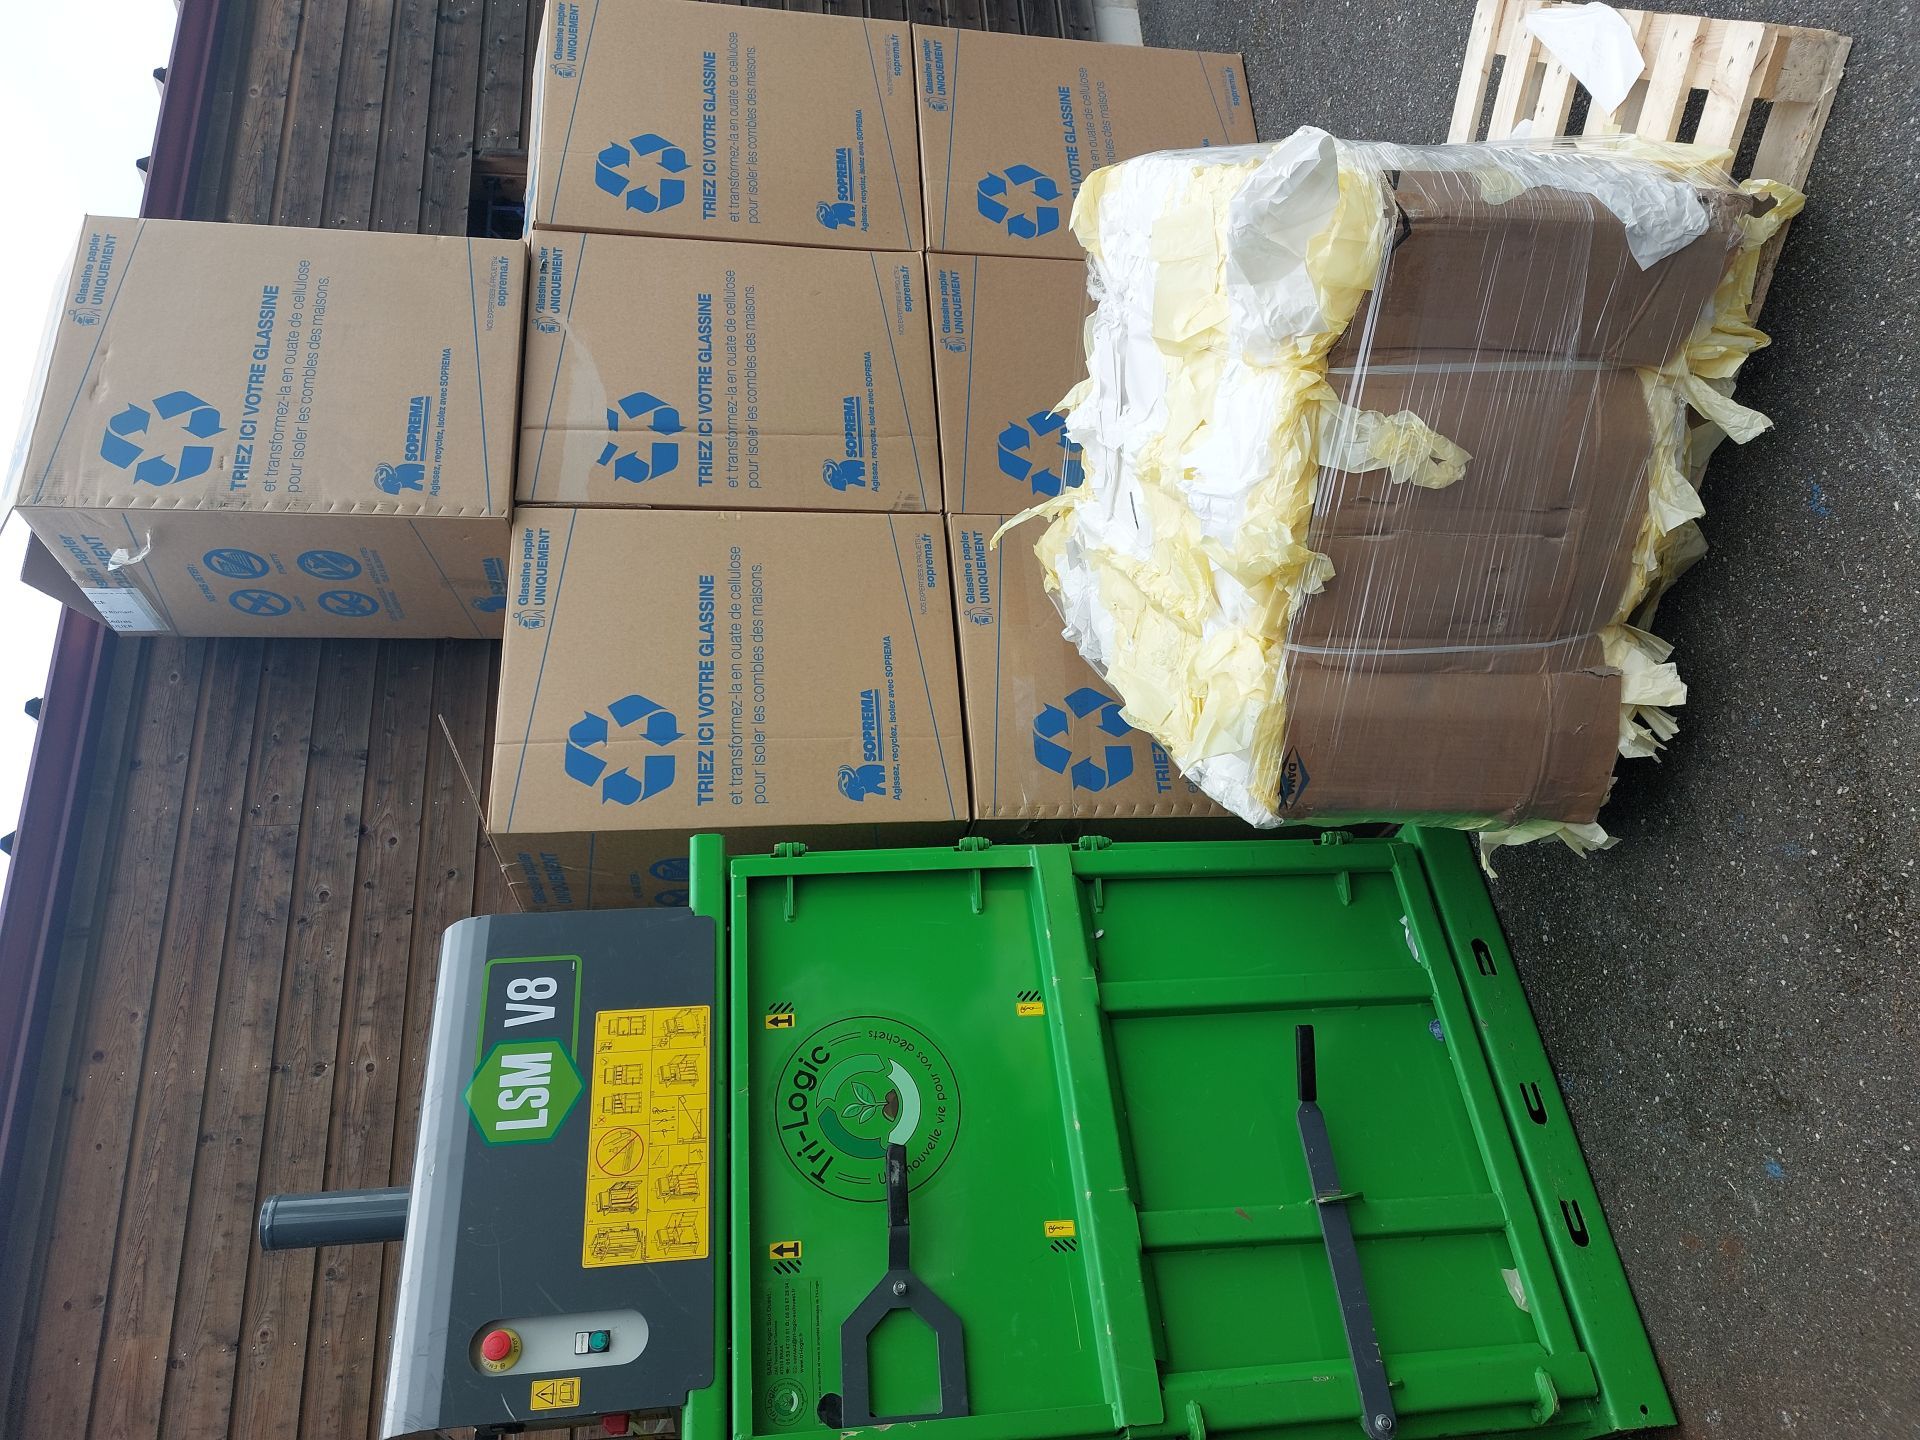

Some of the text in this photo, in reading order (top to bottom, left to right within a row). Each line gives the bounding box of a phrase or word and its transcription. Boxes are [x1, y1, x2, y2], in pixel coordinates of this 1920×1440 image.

[554, 2, 566, 60] Glassine papier
[567, 4, 578, 61] UNIQUEMENT
[890, 34, 902, 76] soprema.fr
[923, 39, 934, 94] Glassine papier
[934, 40, 946, 96] UNIQUEMENT
[1079, 67, 1092, 106] cellulose
[1225, 67, 1240, 106] soprema.fr
[745, 88, 757, 106] des
[1083, 107, 1094, 120] de
[703, 51, 716, 220] TRIEZ ICI VOTRE GLASSINE
[727, 32, 740, 222] et transformez-la en ouate de cellulose
[745, 107, 757, 149] combles
[1058, 86, 1082, 186] VOTRE GLASSINE
[1085, 121, 1097, 148] ouate
[1101, 120, 1112, 138] des
[746, 151, 758, 165] les
[746, 167, 758, 195] isoler
[836, 148, 848, 201] SOPREMA
[1090, 149, 1100, 162] en
[749, 197, 761, 224] pour
[75, 233, 100, 304] Glassine papier
[91, 234, 117, 305] UNIQUEMENT
[498, 256, 508, 306] soprema.fr
[536, 276, 546, 313] Glassine
[900, 266, 913, 312] soprema.fr
[939, 269, 951, 334] Glassine papier
[950, 270, 964, 334] UNIQUEMENT
[230, 286, 279, 491] TRIEZ ICI VOTRE GLASSINE
[262, 260, 310, 492] et transformez-la en ouate de cellulose
[288, 276, 329, 493] pour isoler les combles des maisons.
[440, 348, 451, 387] SOPREMA
[698, 293, 712, 487] TRIEZ ICI VOTRE GLASSINE
[723, 270, 739, 488] et transformez-la en ouate de cellulose
[743, 285, 762, 488] pour isoler les combles des maisons.
[864, 351, 873, 387] SOPREMA
[405, 397, 424, 461] SOPREMA
[436, 406, 446, 428] isolez
[843, 397, 857, 458] SOPREMA
[434, 429, 445, 463] recyclez,
[429, 464, 442, 496] Agissez,
[871, 461, 880, 492] Agissez,
[517, 528, 534, 606] Glassine papier
[534, 528, 549, 605] UNIQUEMENT
[921, 534, 936, 588] soprema.fr
[960, 531, 975, 604] Glassine papier
[973, 531, 990, 603] UNIQUEMENT
[727, 546, 743, 805] et transformez-la en ouate de cellulose
[883, 636, 893, 677] SOPREMA
[697, 575, 715, 806] TRIEZ ICI VOTRE GLASSINE
[750, 563, 769, 804] pour isoler les combles des maisons.
[860, 689, 876, 762] SOPREMA
[888, 700, 896, 723] isolez
[890, 725, 900, 762] recyclez,
[892, 764, 902, 800] Agissez,
[1288, 762, 1296, 794] DANA
[540, 852, 572, 904] UNIQUEMENT
[496, 977, 557, 1130] LSM V8
[868, 1030, 915, 1052] déchets
[916, 1051, 932, 1070] vos
[930, 1073, 947, 1101] pour
[782, 1046, 834, 1184] Tri-Logic
[936, 1106, 945, 1124] vie
